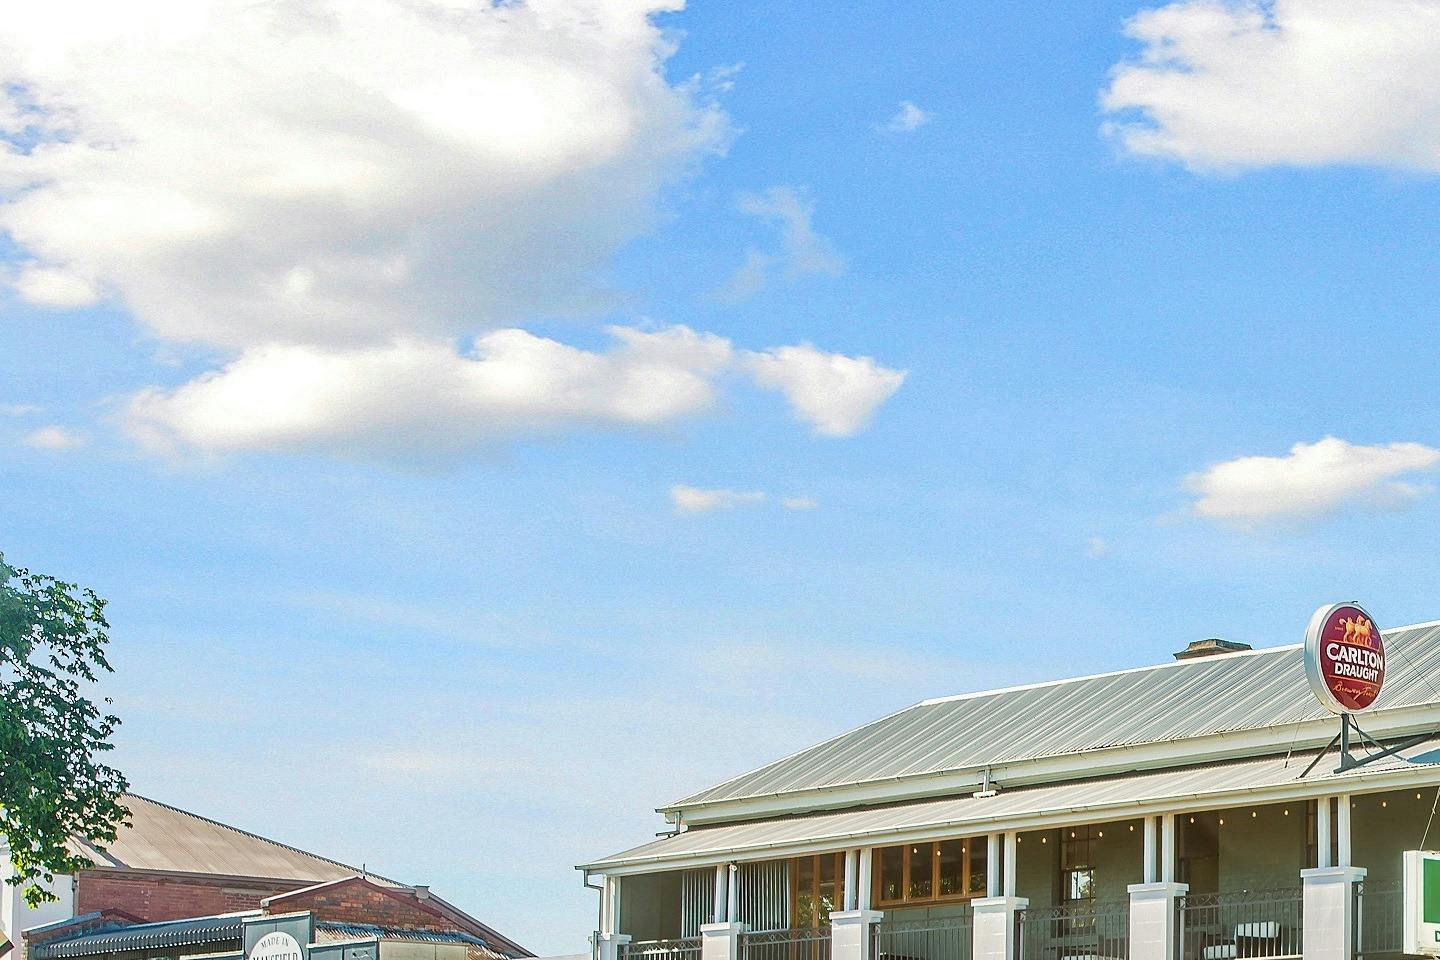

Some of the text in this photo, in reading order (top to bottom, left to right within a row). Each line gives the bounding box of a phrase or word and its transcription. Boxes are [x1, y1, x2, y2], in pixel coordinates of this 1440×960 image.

[1326, 643, 1383, 671] CARLTON
[1334, 662, 1379, 682] DRAUGHT
[261, 936, 289, 948] MADE IN
